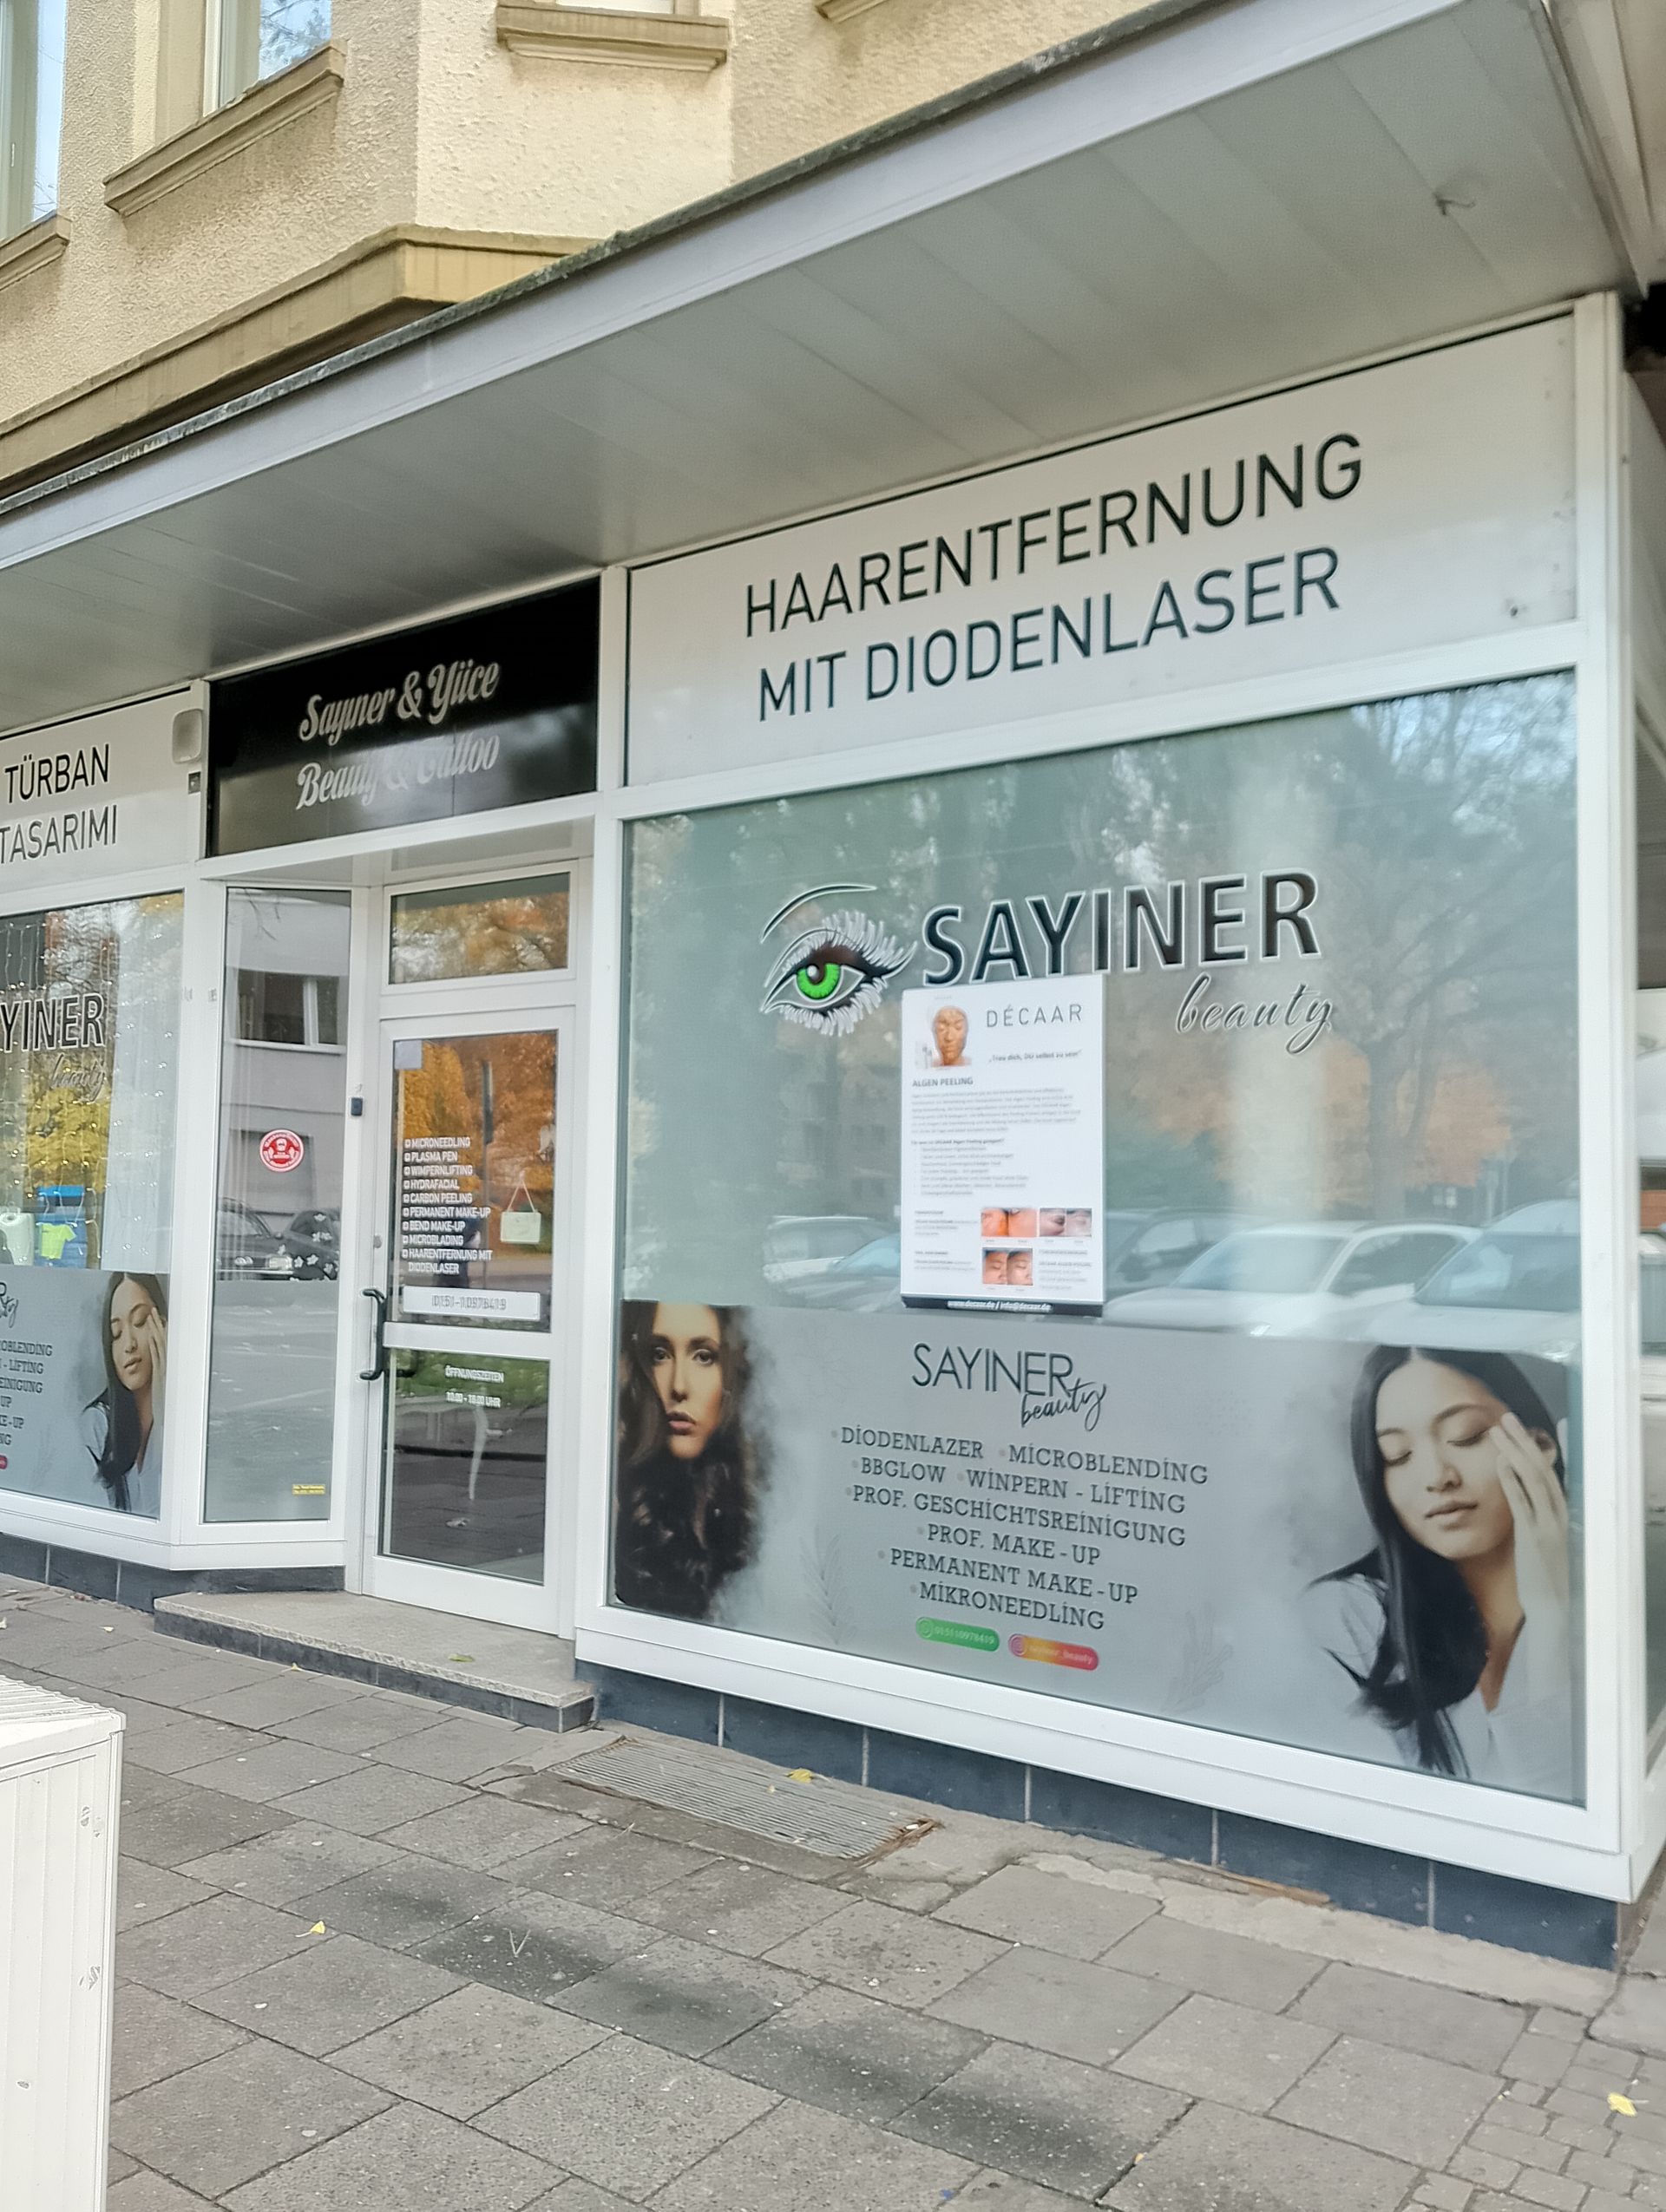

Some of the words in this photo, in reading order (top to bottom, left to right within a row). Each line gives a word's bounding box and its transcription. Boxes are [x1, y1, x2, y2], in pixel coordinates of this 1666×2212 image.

[746, 432, 1362, 638] HAARENTFERNUNG
[758, 651, 847, 722] MIT
[867, 546, 1341, 702] DIODENLASER
[397, 671, 423, 719] &
[4, 743, 109, 803] TÜRBAN
[0, 804, 117, 864] TASARIMI
[922, 867, 1322, 987] SAYINER
[987, 1004, 1083, 1028] DÉCAAR
[1176, 972, 1333, 1055] beauty
[912, 1343, 1073, 1397] SAYINER
[1021, 1378, 1106, 1431] beauty
[861, 1456, 946, 1482] BBGLOW
[853, 1484, 907, 1508] PROF.
[928, 1522, 985, 1548] PROF.
[890, 1548, 1020, 1586] PERMANENT
